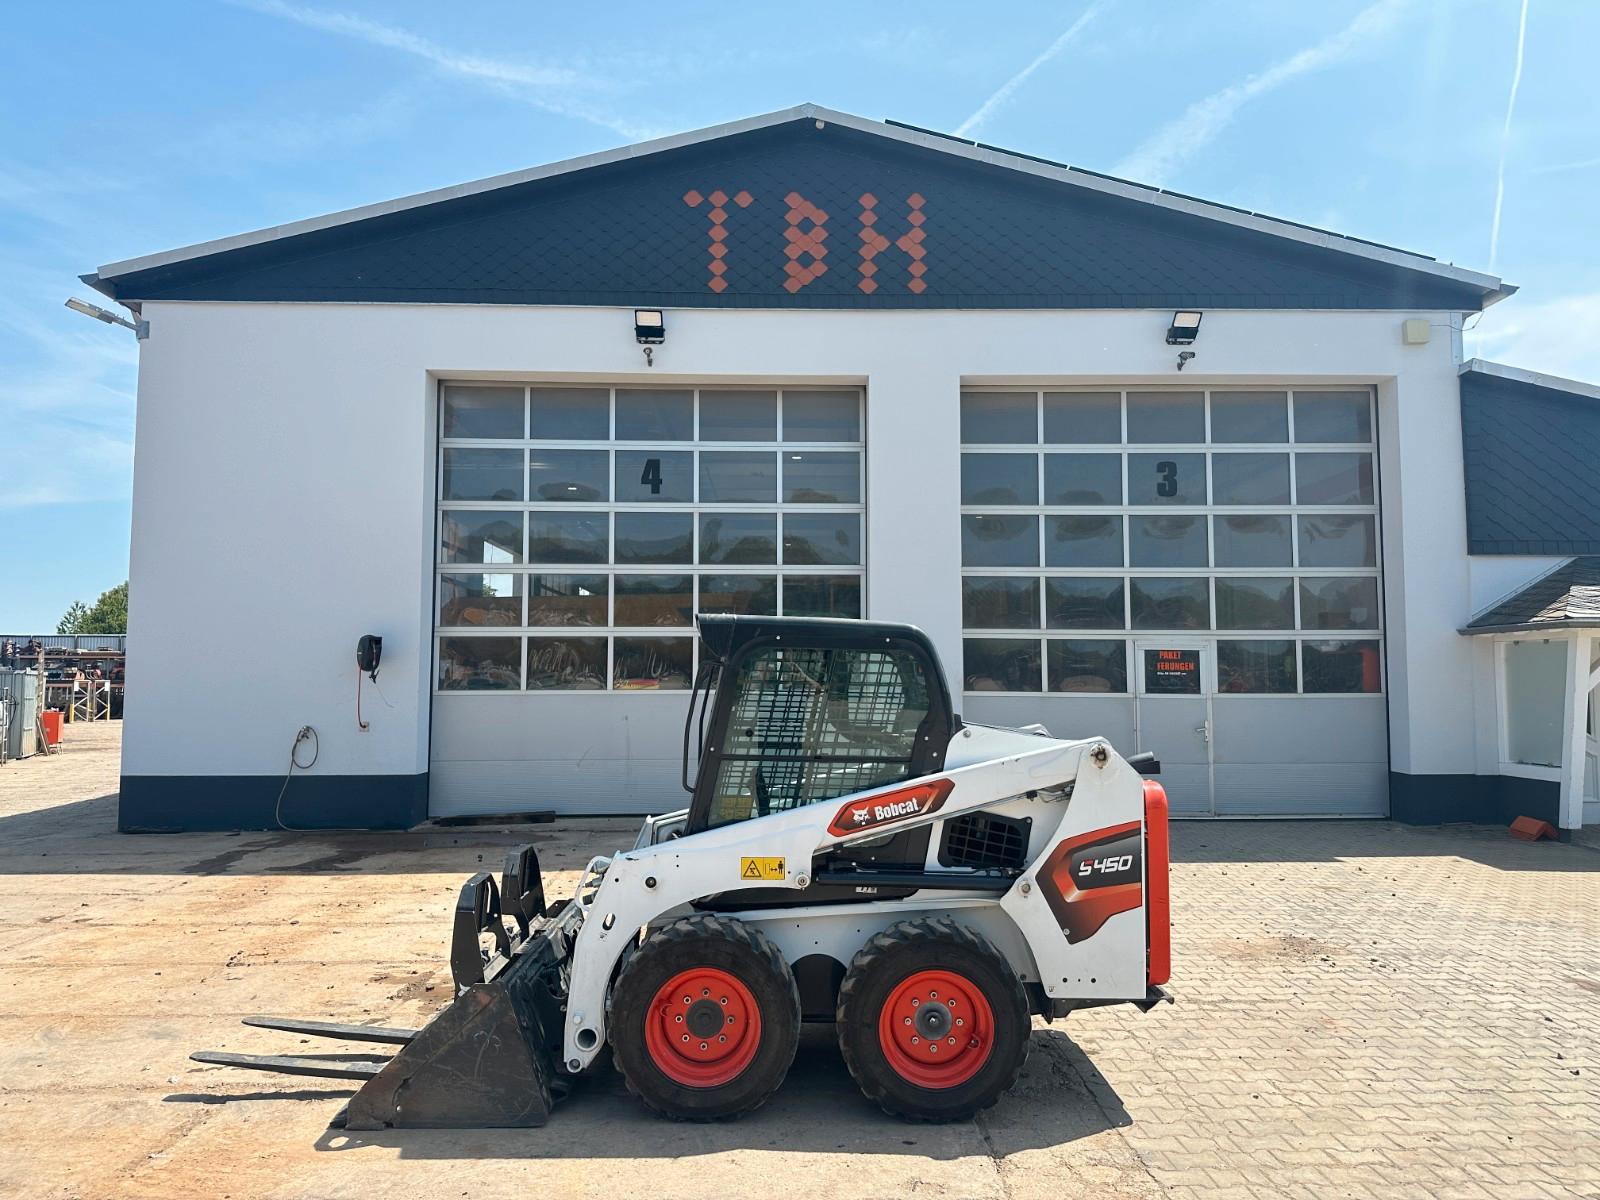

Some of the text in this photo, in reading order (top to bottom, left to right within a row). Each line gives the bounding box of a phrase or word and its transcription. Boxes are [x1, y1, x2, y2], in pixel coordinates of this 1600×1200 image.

[683, 190, 928, 294] TBH
[641, 459, 662, 494] 4
[1157, 461, 1177, 497] 3
[874, 797, 919, 821] Bobcat
[1078, 855, 1133, 876] S450
